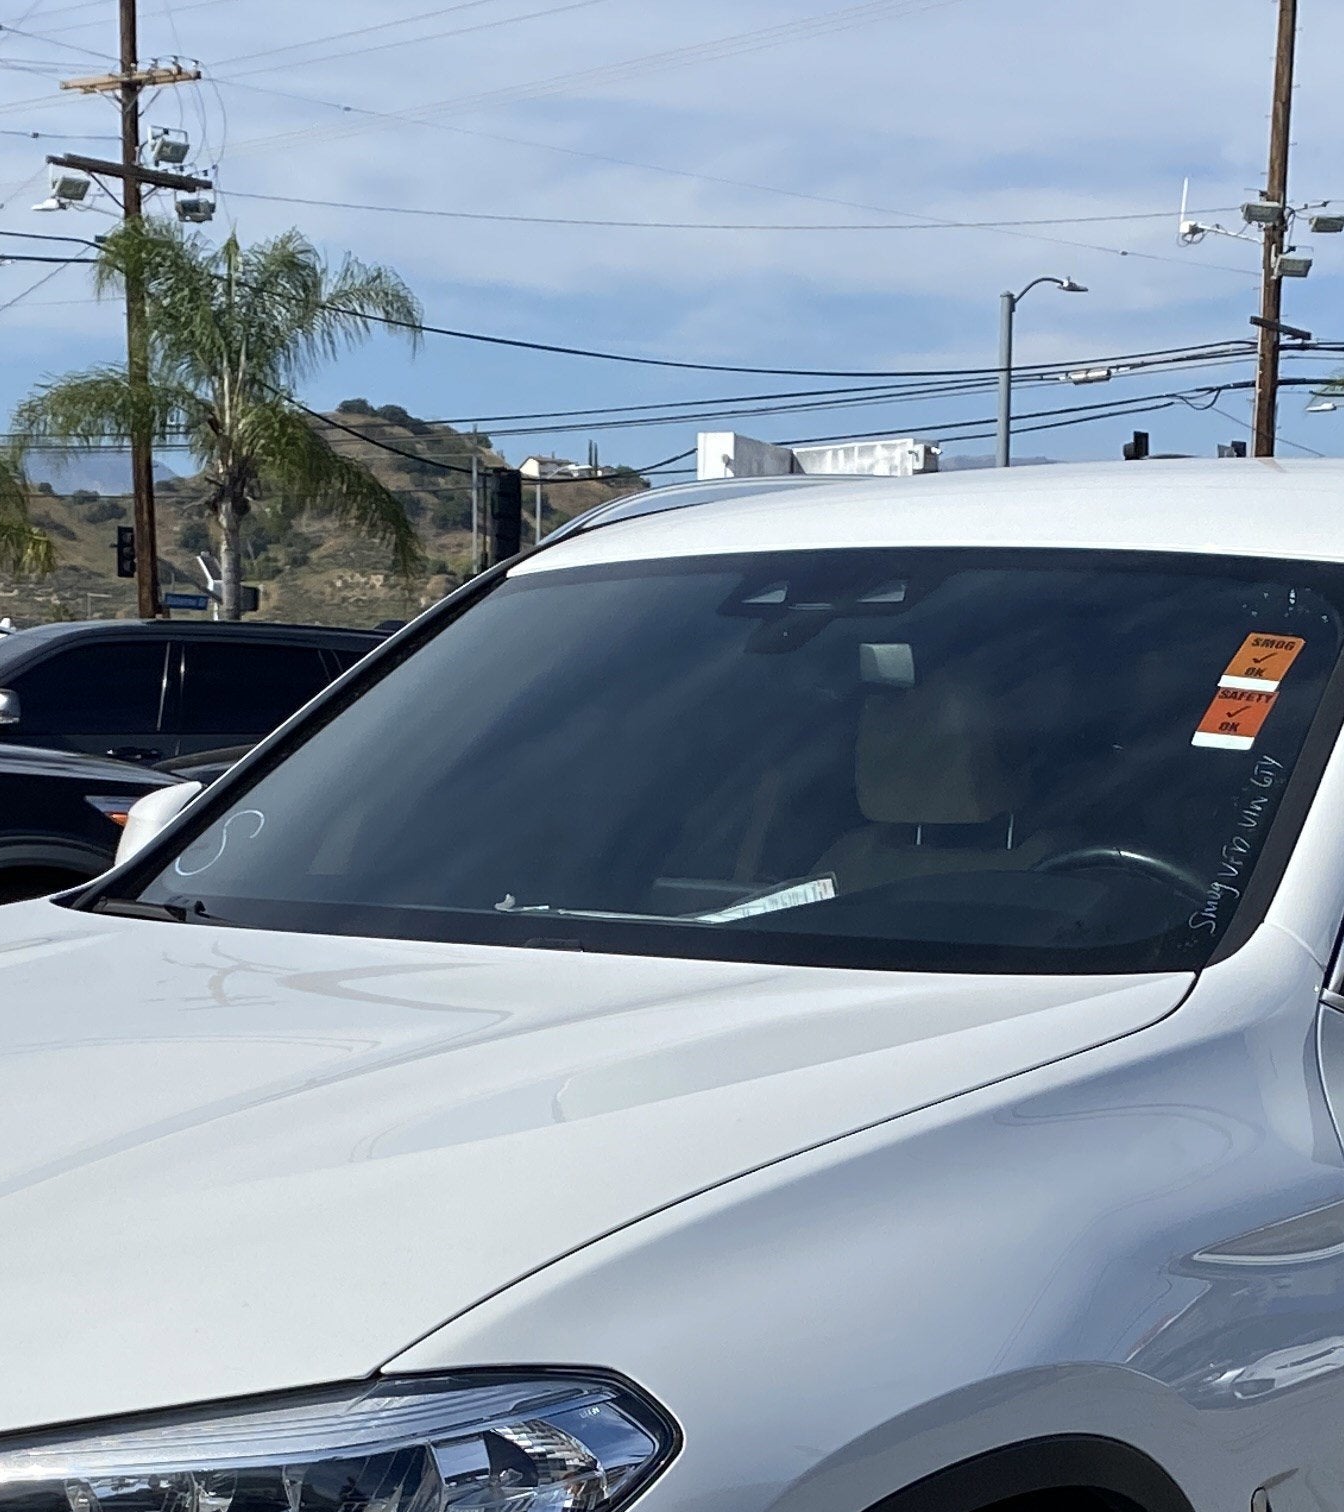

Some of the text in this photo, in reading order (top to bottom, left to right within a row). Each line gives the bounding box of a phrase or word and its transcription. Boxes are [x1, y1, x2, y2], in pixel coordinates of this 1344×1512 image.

[1251, 637, 1296, 651] SMOG
[1244, 666, 1265, 677] OK
[1218, 689, 1274, 704] SAFETY
[1219, 721, 1240, 732] OK
